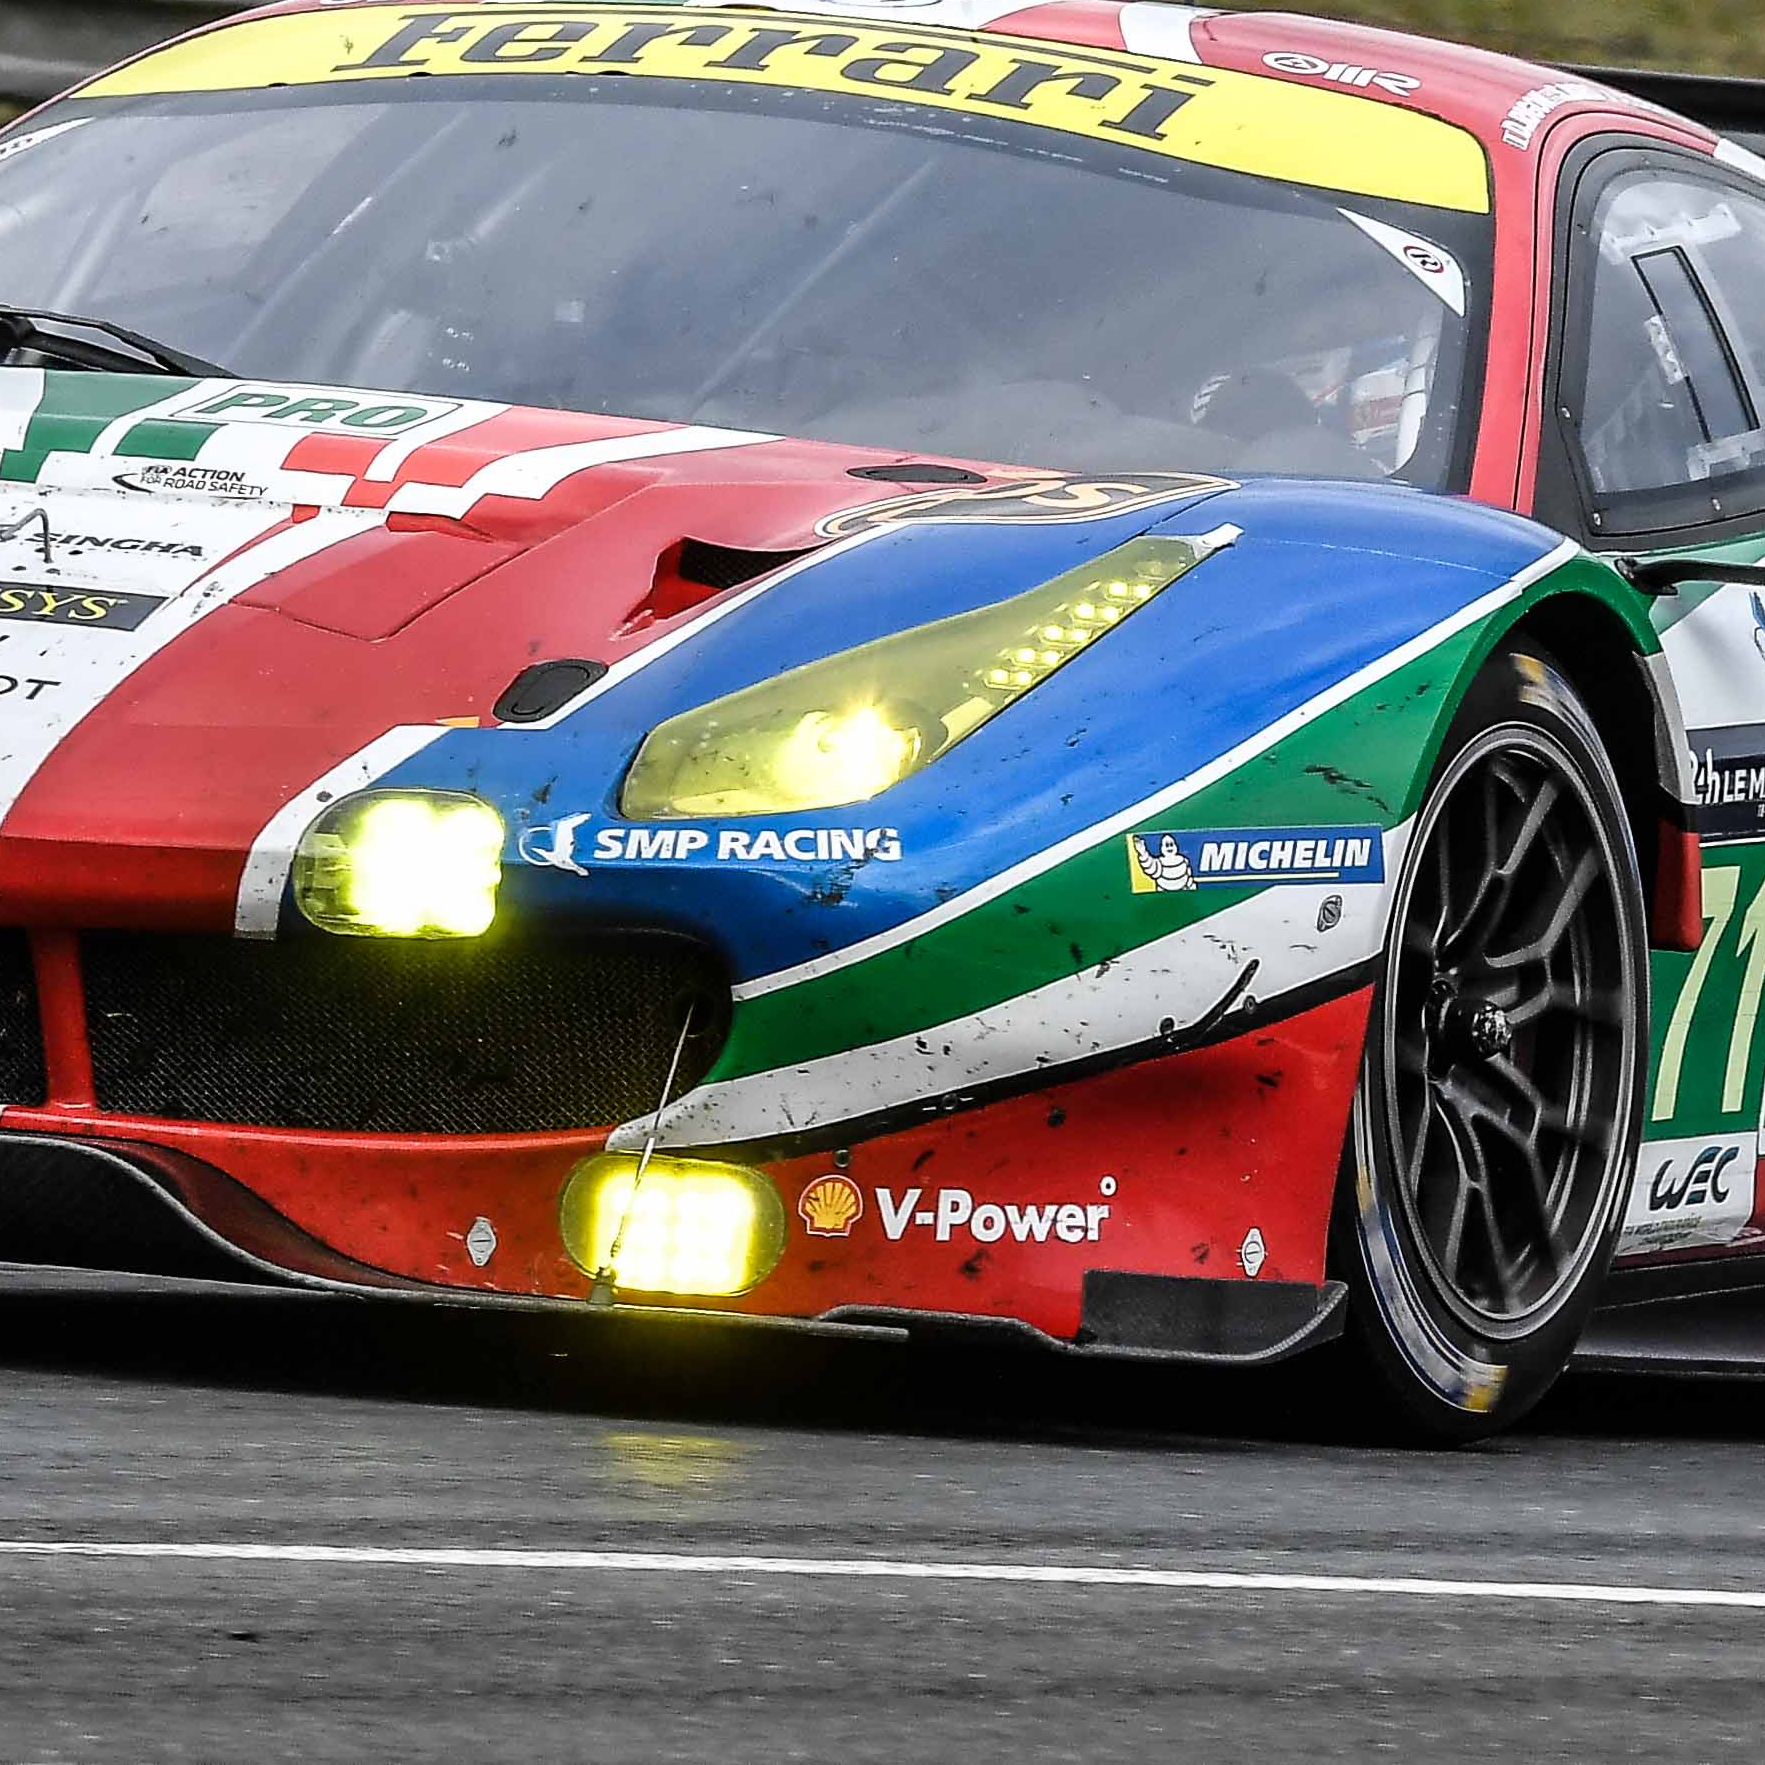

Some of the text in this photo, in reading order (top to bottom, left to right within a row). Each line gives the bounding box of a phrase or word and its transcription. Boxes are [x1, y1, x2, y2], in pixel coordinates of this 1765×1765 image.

[331, 5, 1216, 141] Ferrari
[196, 391, 432, 431] PRO
[163, 478, 206, 490] ROAD
[207, 481, 269, 496] SAFETY
[172, 467, 246, 482] ACTION
[25, 532, 203, 558] SINGHA
[1722, 769, 1748, 803] LE
[595, 826, 902, 863] SMP RACING
[1198, 836, 1372, 874] MICHELIN
[1649, 1145, 1740, 1211] WEC
[874, 1187, 1111, 1244] V-Power
